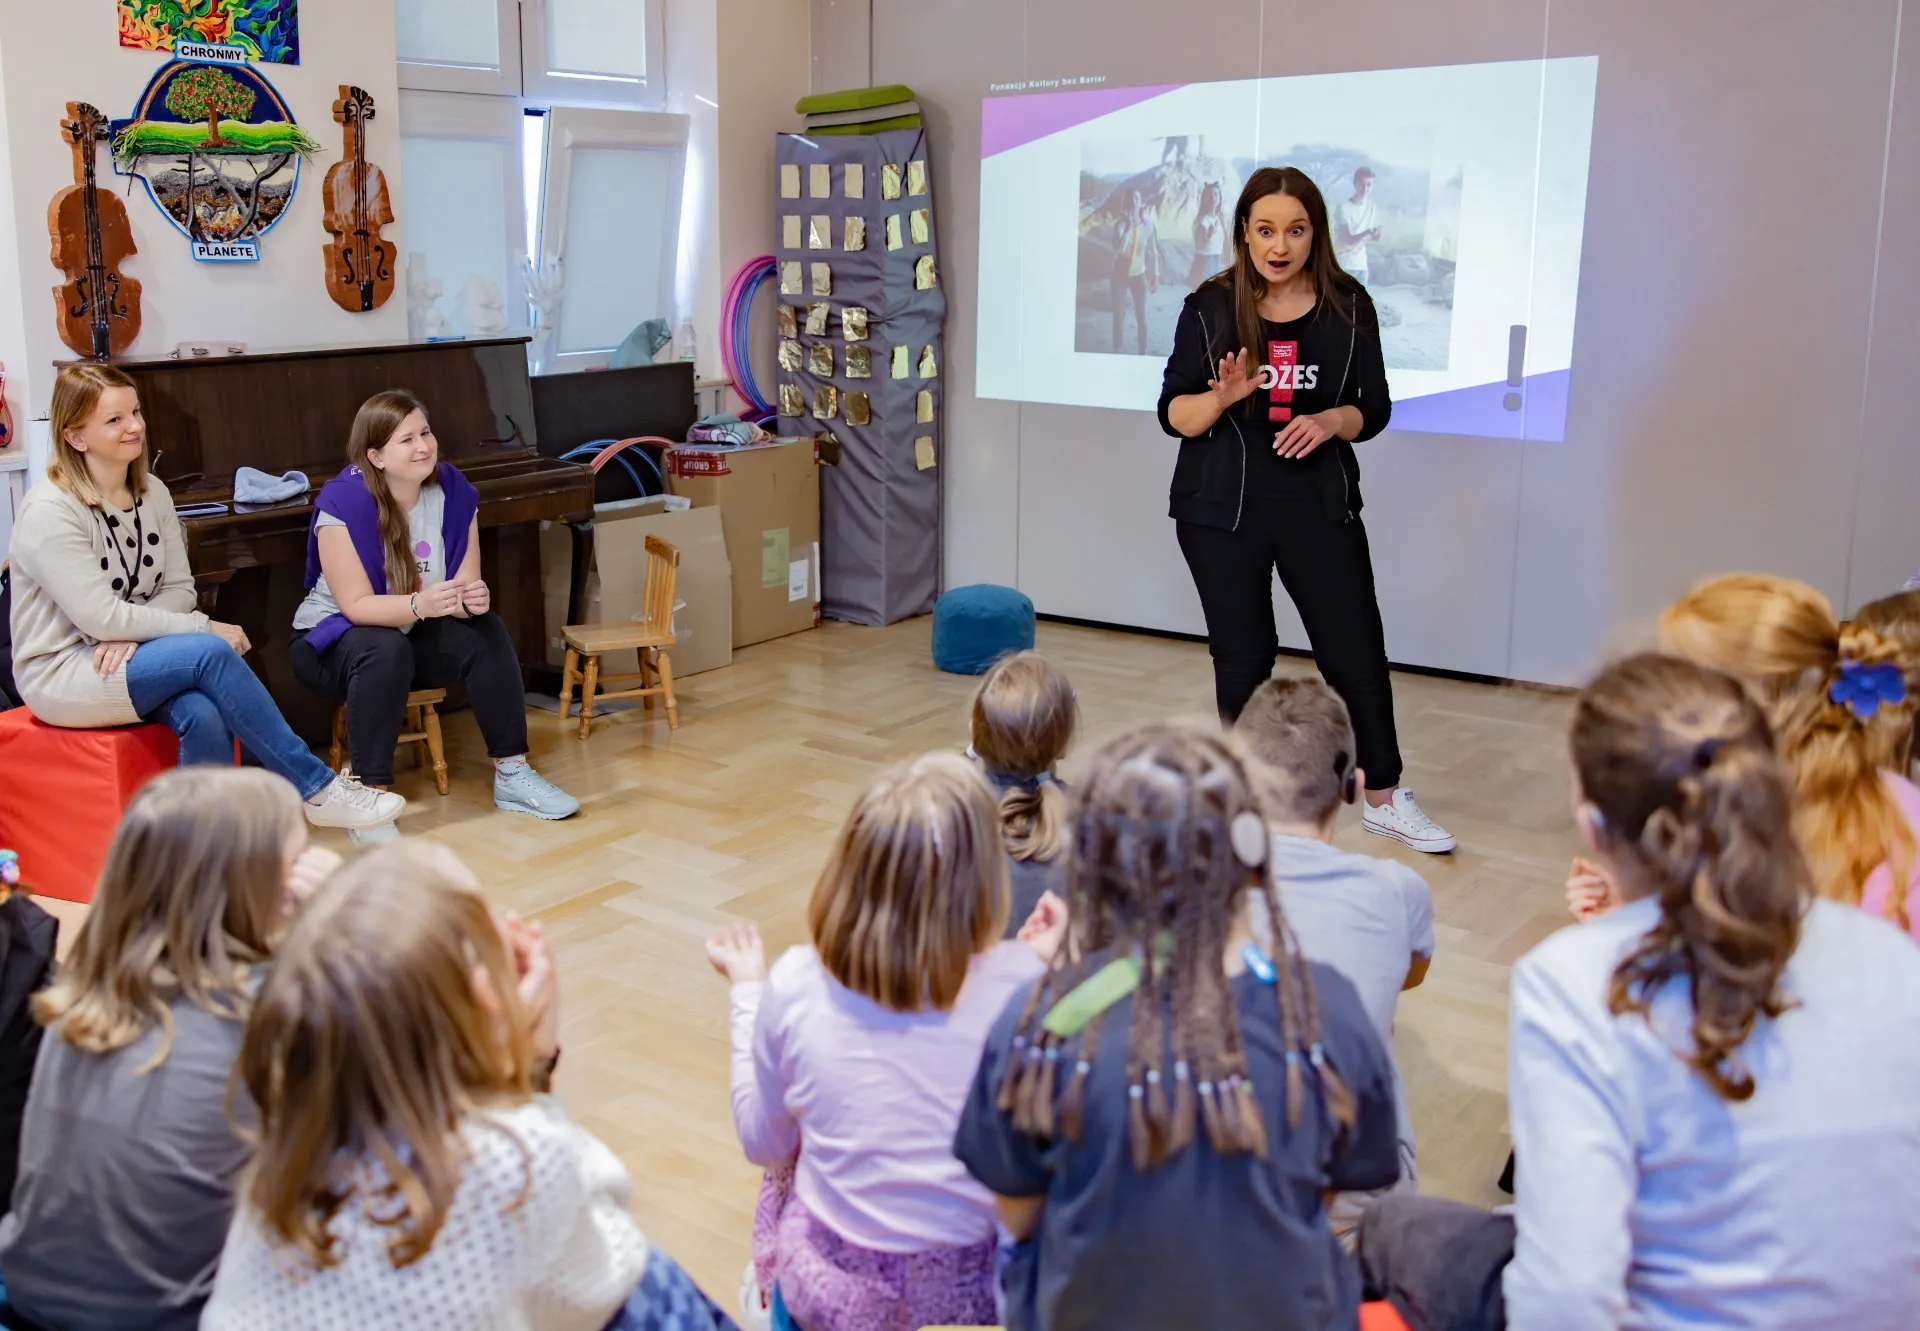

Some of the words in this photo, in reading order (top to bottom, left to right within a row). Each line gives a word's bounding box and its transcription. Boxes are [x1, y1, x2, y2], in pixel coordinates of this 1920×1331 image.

[181, 45, 241, 61] CHROŃMY
[1029, 79, 1059, 88] Kultury
[1062, 78, 1076, 86] bez
[1080, 75, 1106, 84] Barier
[198, 246, 254, 259] PLANETĘ
[683, 460, 710, 471] GROUP
